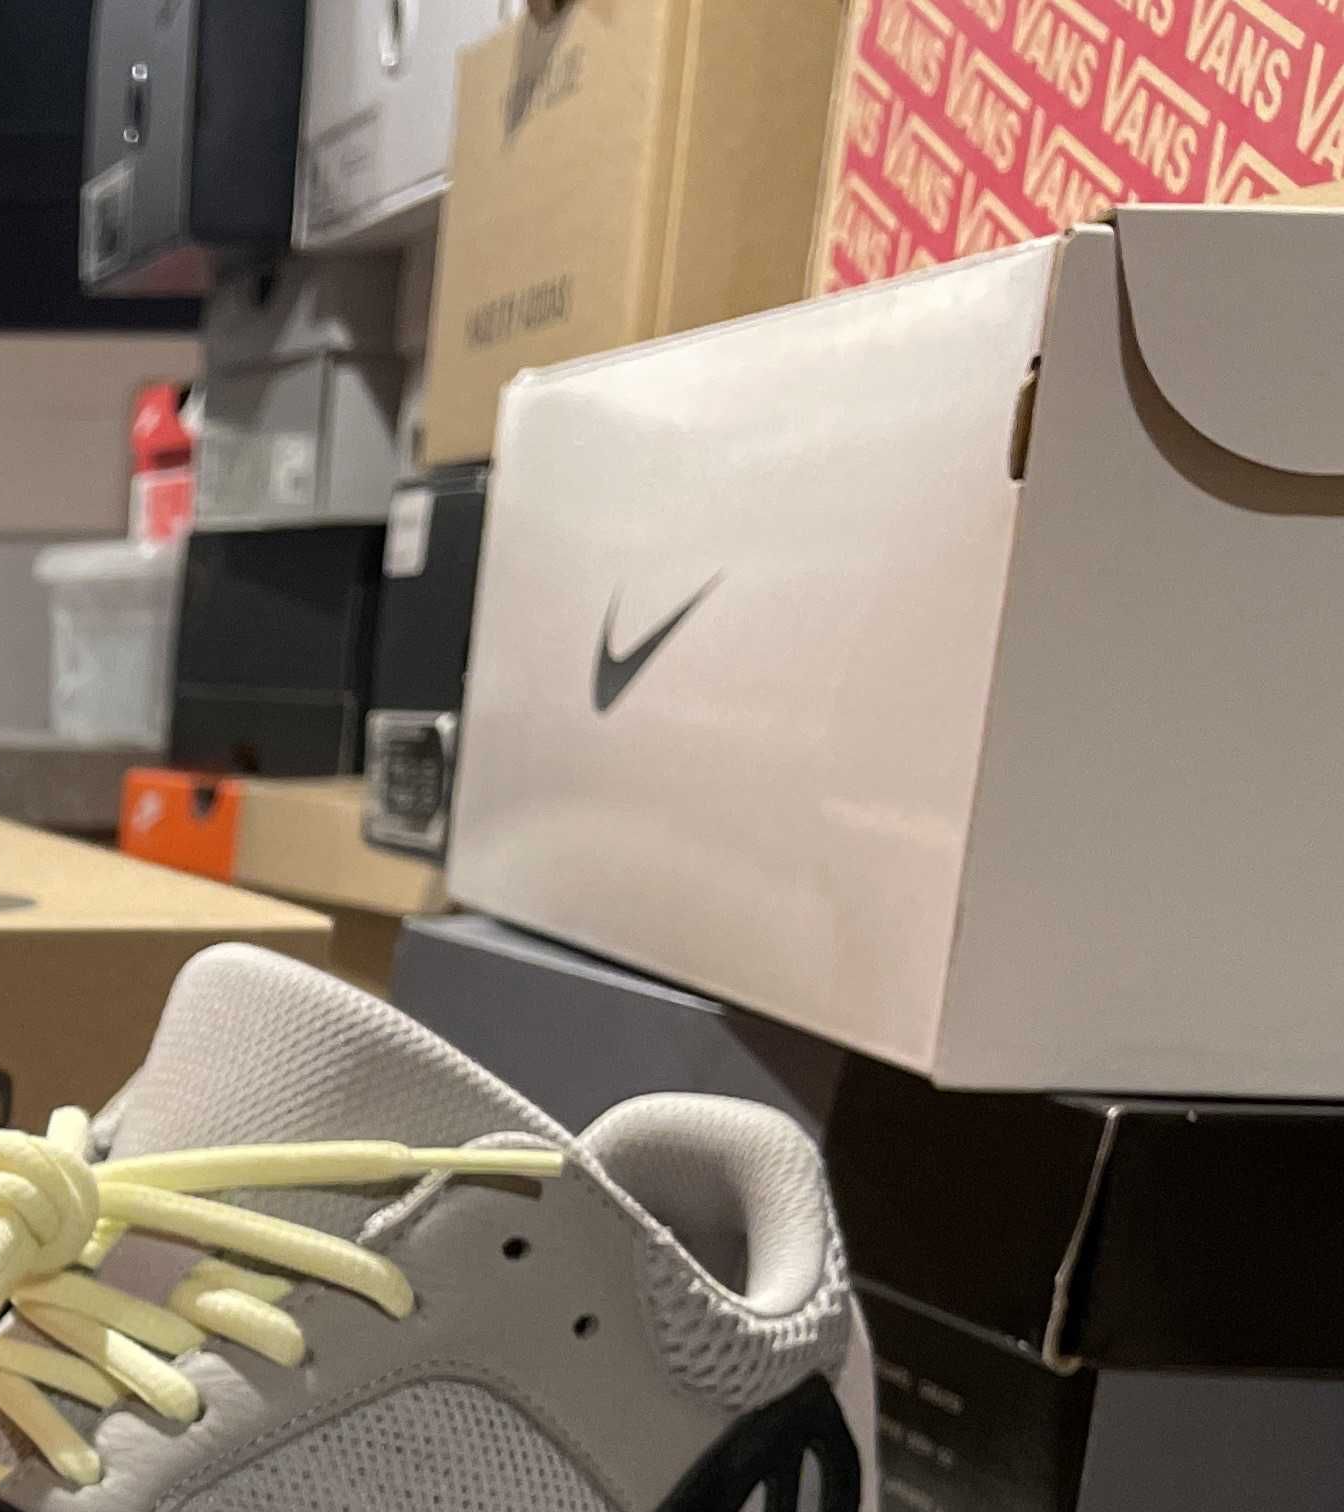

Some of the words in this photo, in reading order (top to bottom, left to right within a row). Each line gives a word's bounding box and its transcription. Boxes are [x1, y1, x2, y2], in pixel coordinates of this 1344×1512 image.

[944, 32, 1033, 172] VANS
[1101, 36, 1211, 195] VANS
[1184, 0, 1306, 122] VANS
[1022, 104, 1125, 233] VAN
